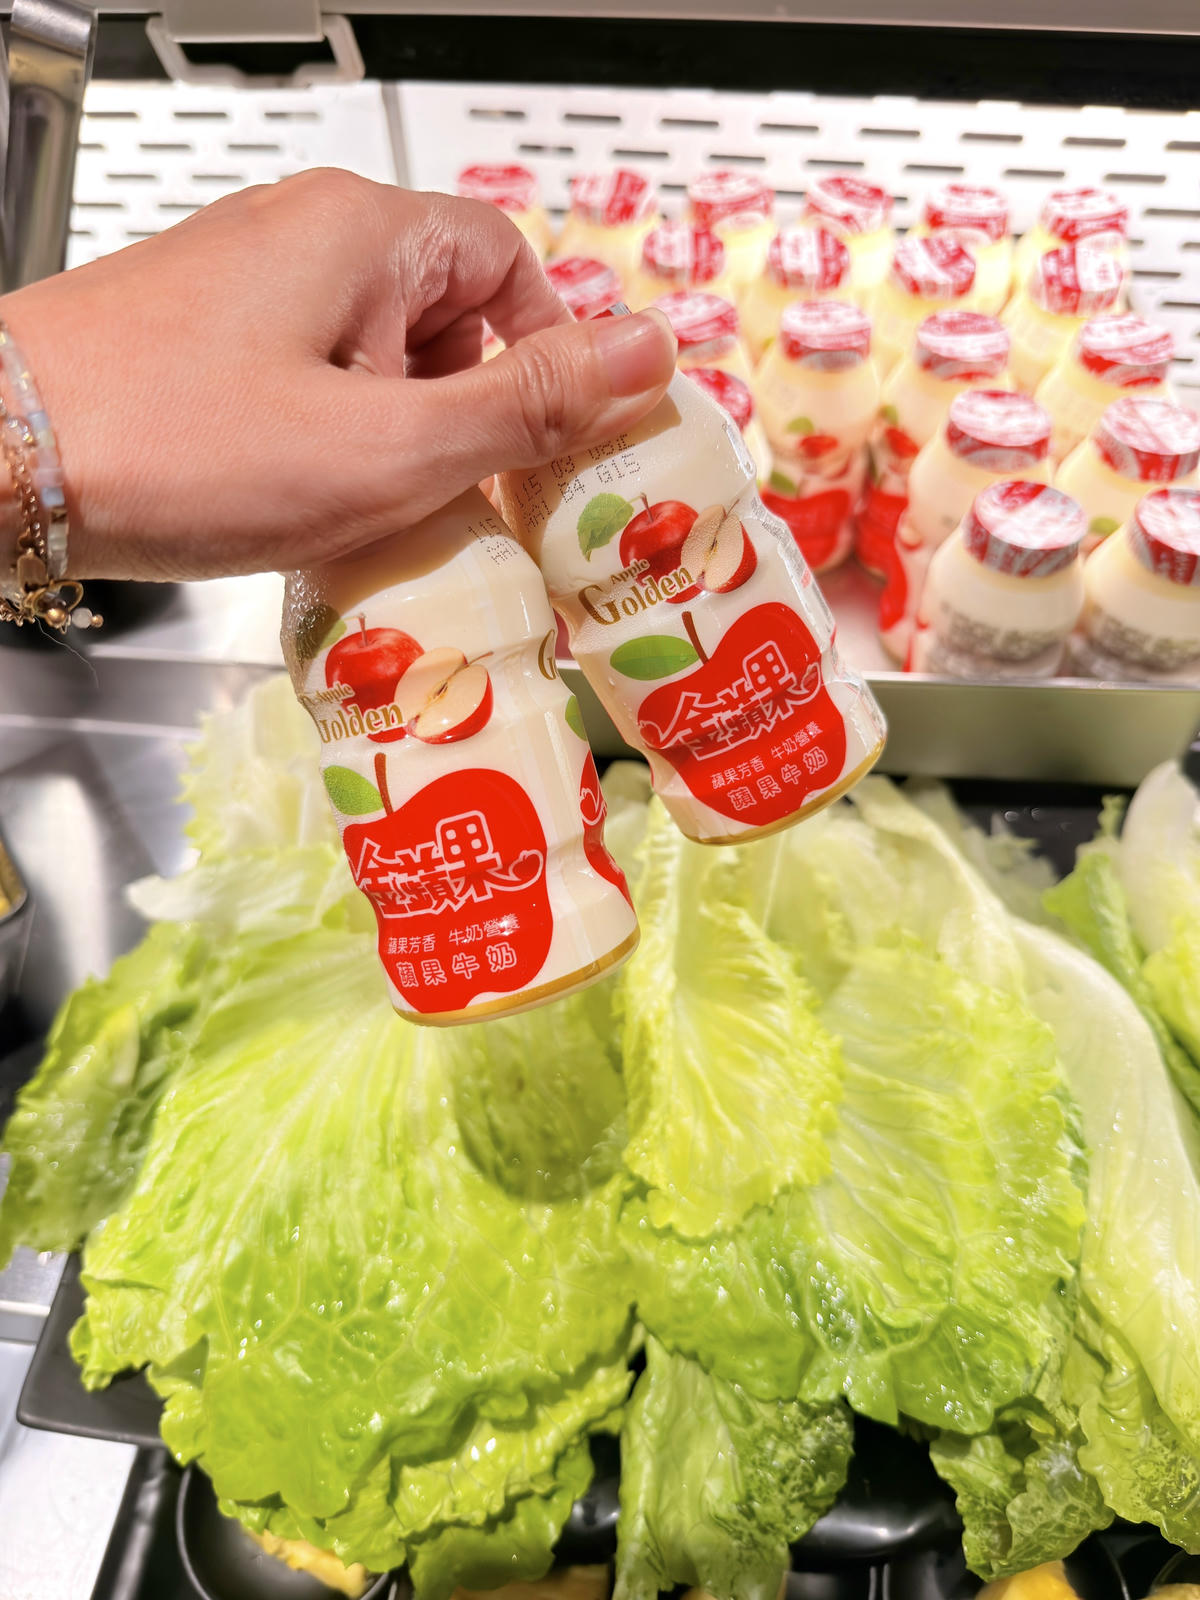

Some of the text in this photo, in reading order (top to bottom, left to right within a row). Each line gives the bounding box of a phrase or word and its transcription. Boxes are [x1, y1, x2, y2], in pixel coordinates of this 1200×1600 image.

[577, 566, 695, 626] Golden
[609, 559, 649, 585] Apple
[727, 746, 829, 811] 蘋果牛奶
[396, 942, 518, 988] 蘋果牛奶
